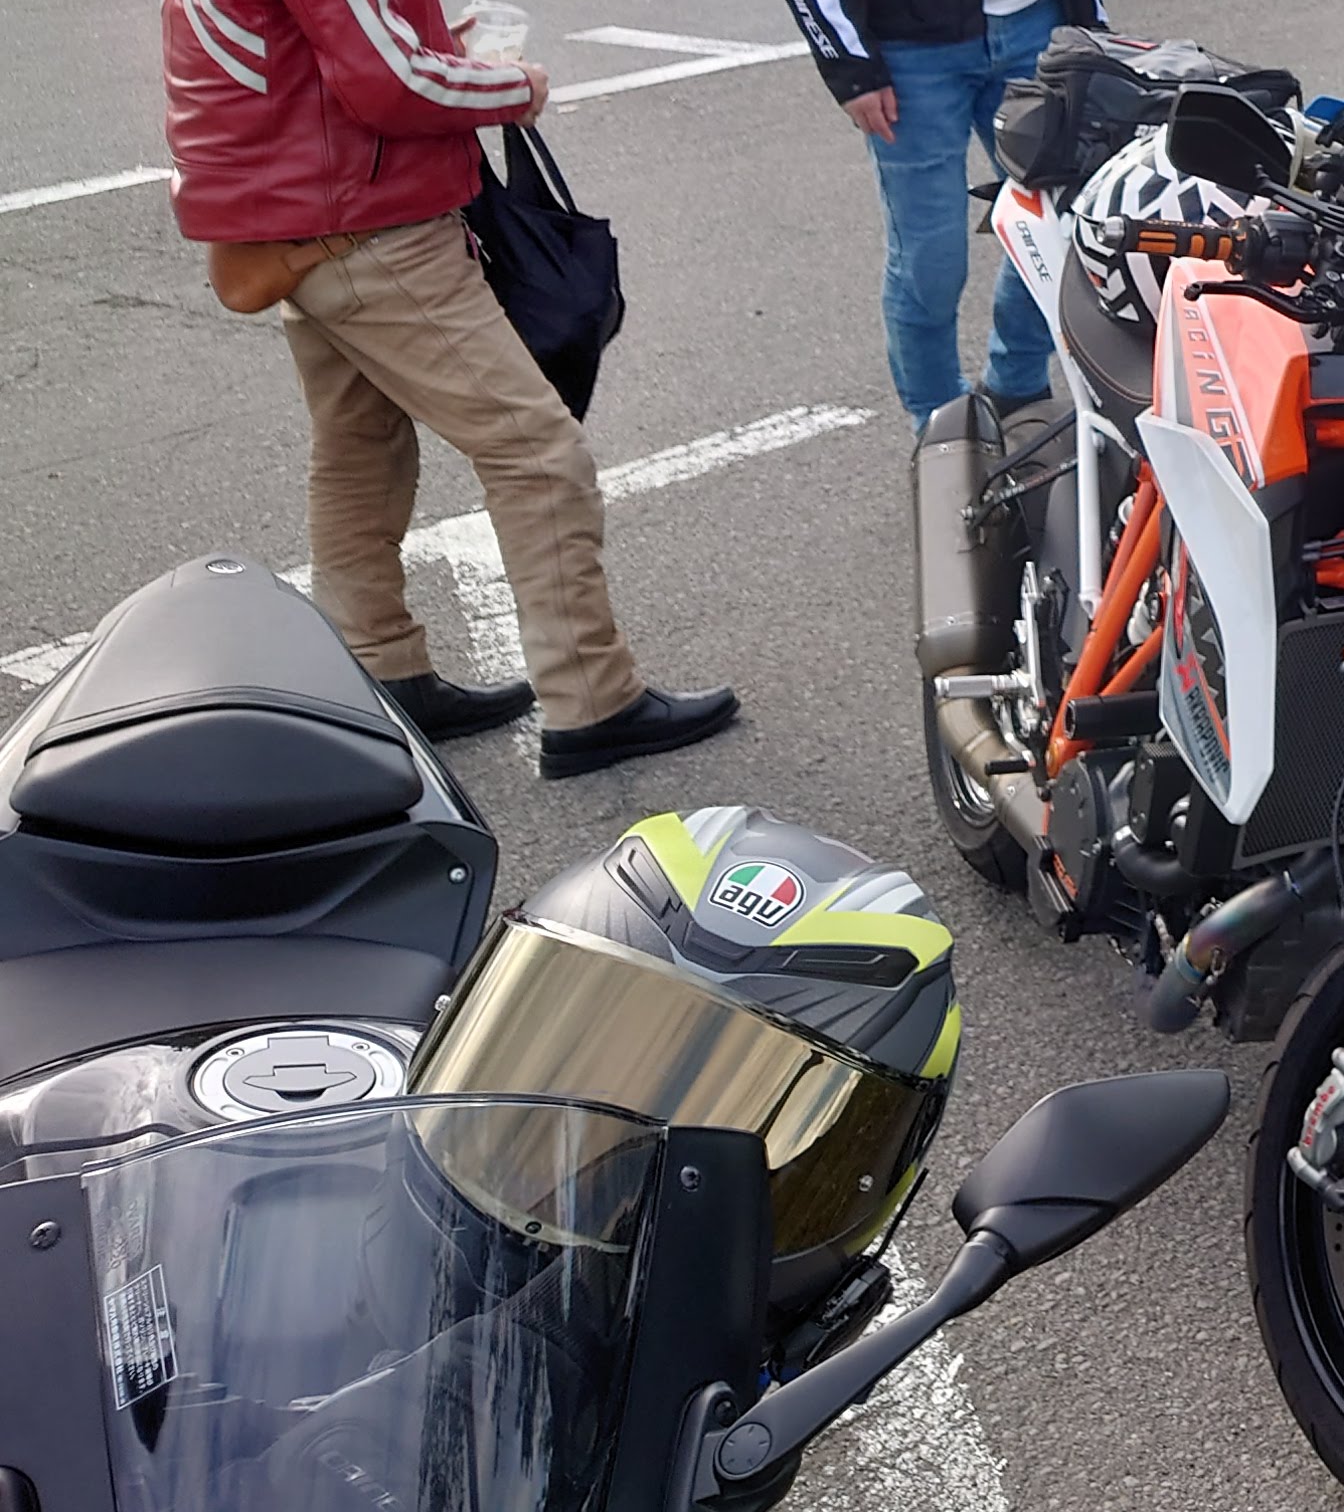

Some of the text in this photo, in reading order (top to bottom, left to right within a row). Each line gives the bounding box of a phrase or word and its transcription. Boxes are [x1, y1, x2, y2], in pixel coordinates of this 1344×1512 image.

[1015, 220, 1053, 283] DAINESE
[719, 884, 785, 921] agv
[1303, 1085, 1335, 1146] brembo
